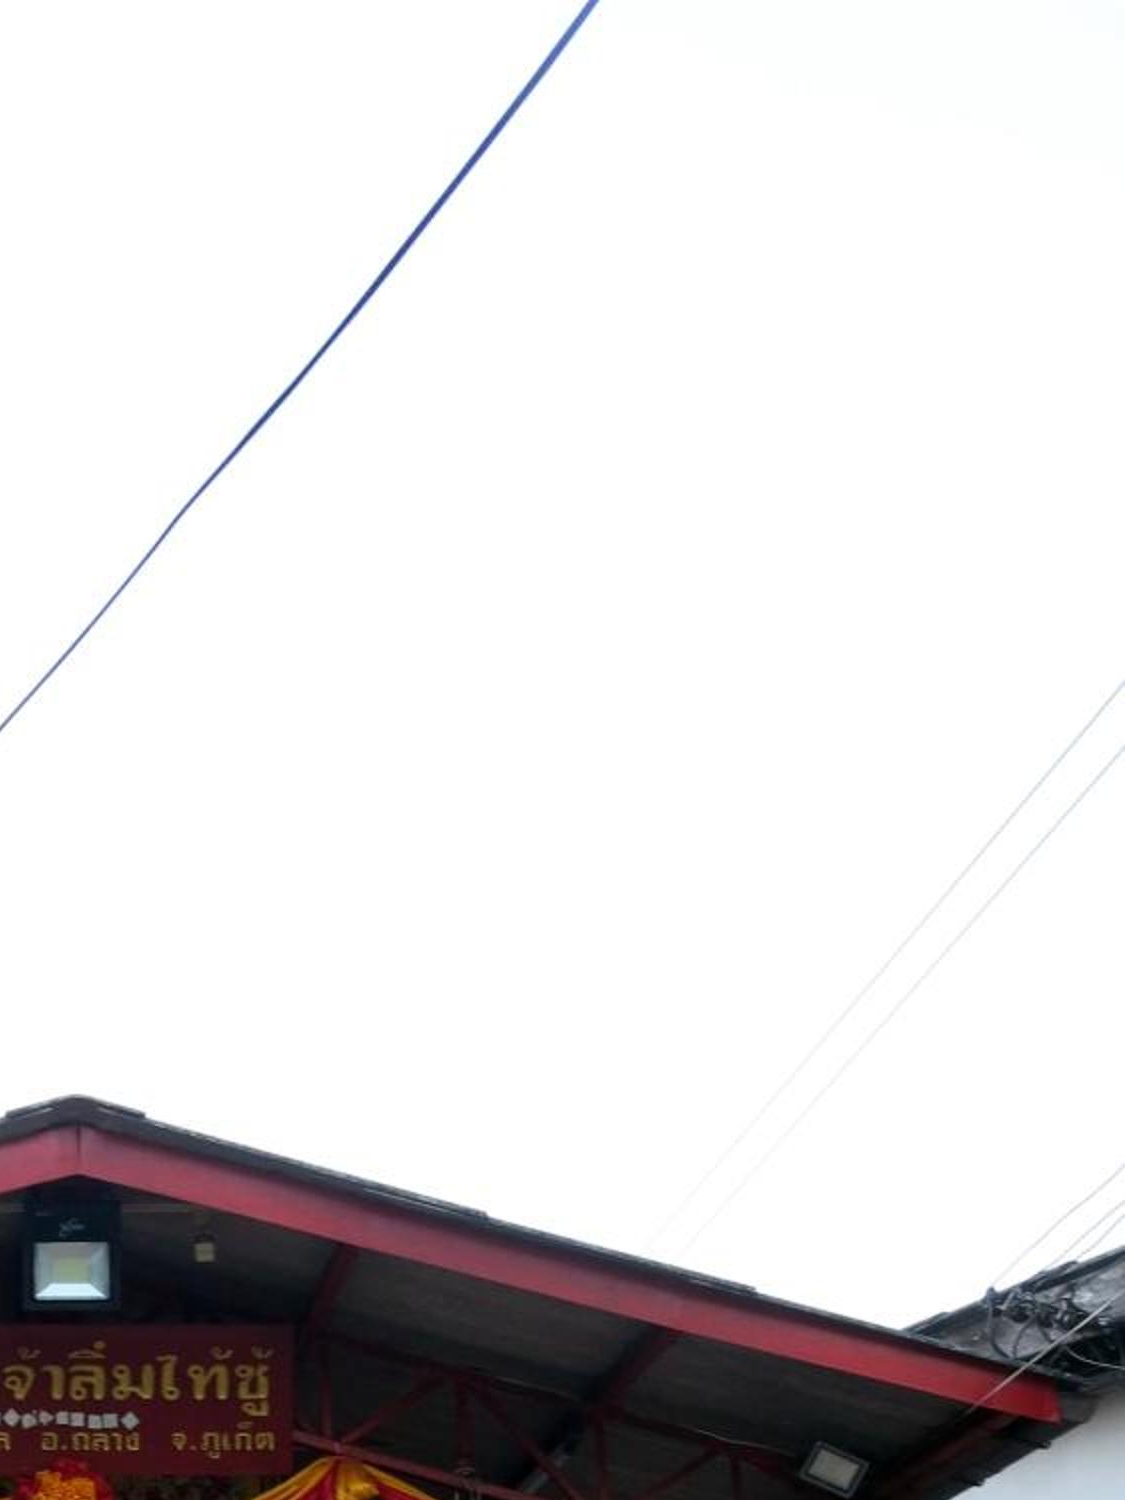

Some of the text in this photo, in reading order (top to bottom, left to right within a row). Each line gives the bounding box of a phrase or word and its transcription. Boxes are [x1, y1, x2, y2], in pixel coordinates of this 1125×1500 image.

[41, 1431, 140, 1452] อ.ถลาง
[171, 1421, 275, 1459] จ.ภูเก็ต
